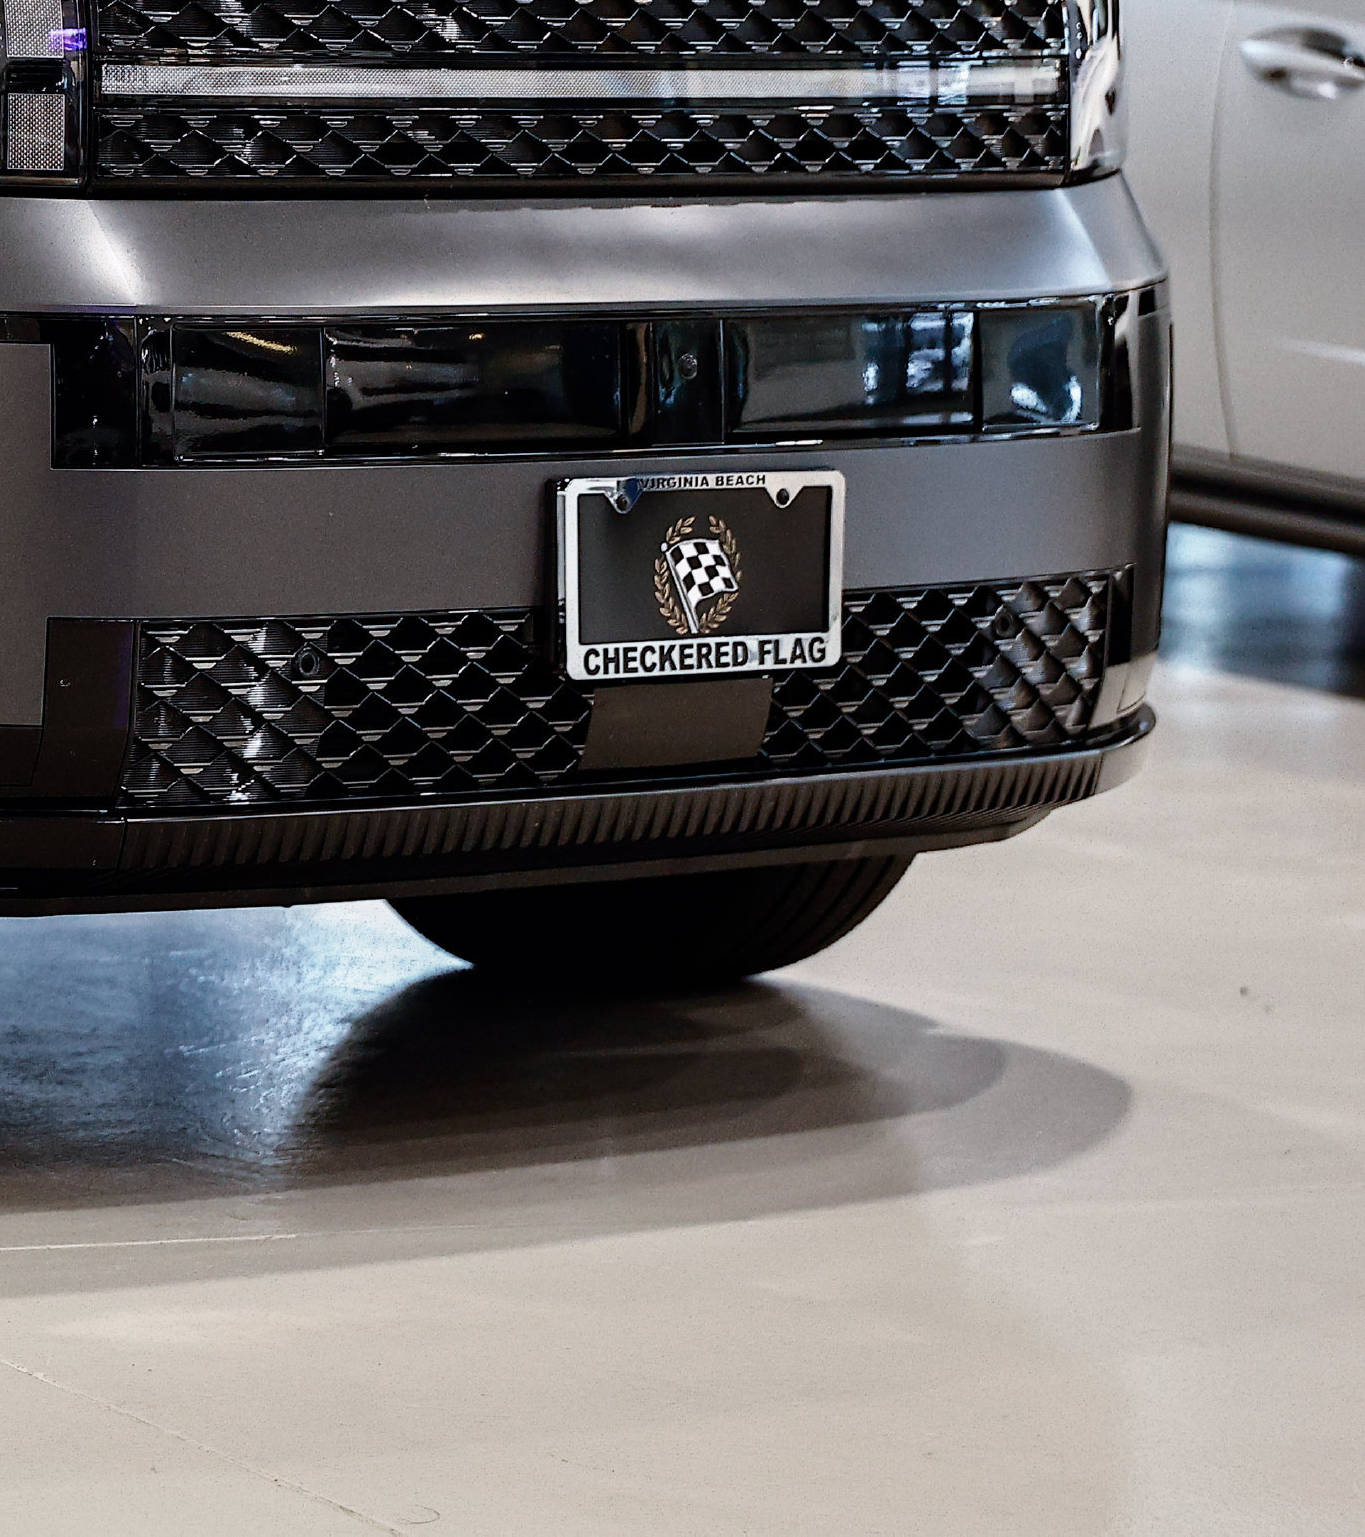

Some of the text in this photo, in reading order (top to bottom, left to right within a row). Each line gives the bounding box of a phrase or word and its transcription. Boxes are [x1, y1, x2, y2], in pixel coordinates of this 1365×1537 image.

[637, 474, 767, 490] VIRGINIA BEACH
[583, 636, 827, 676] CHECKERED FLAG
